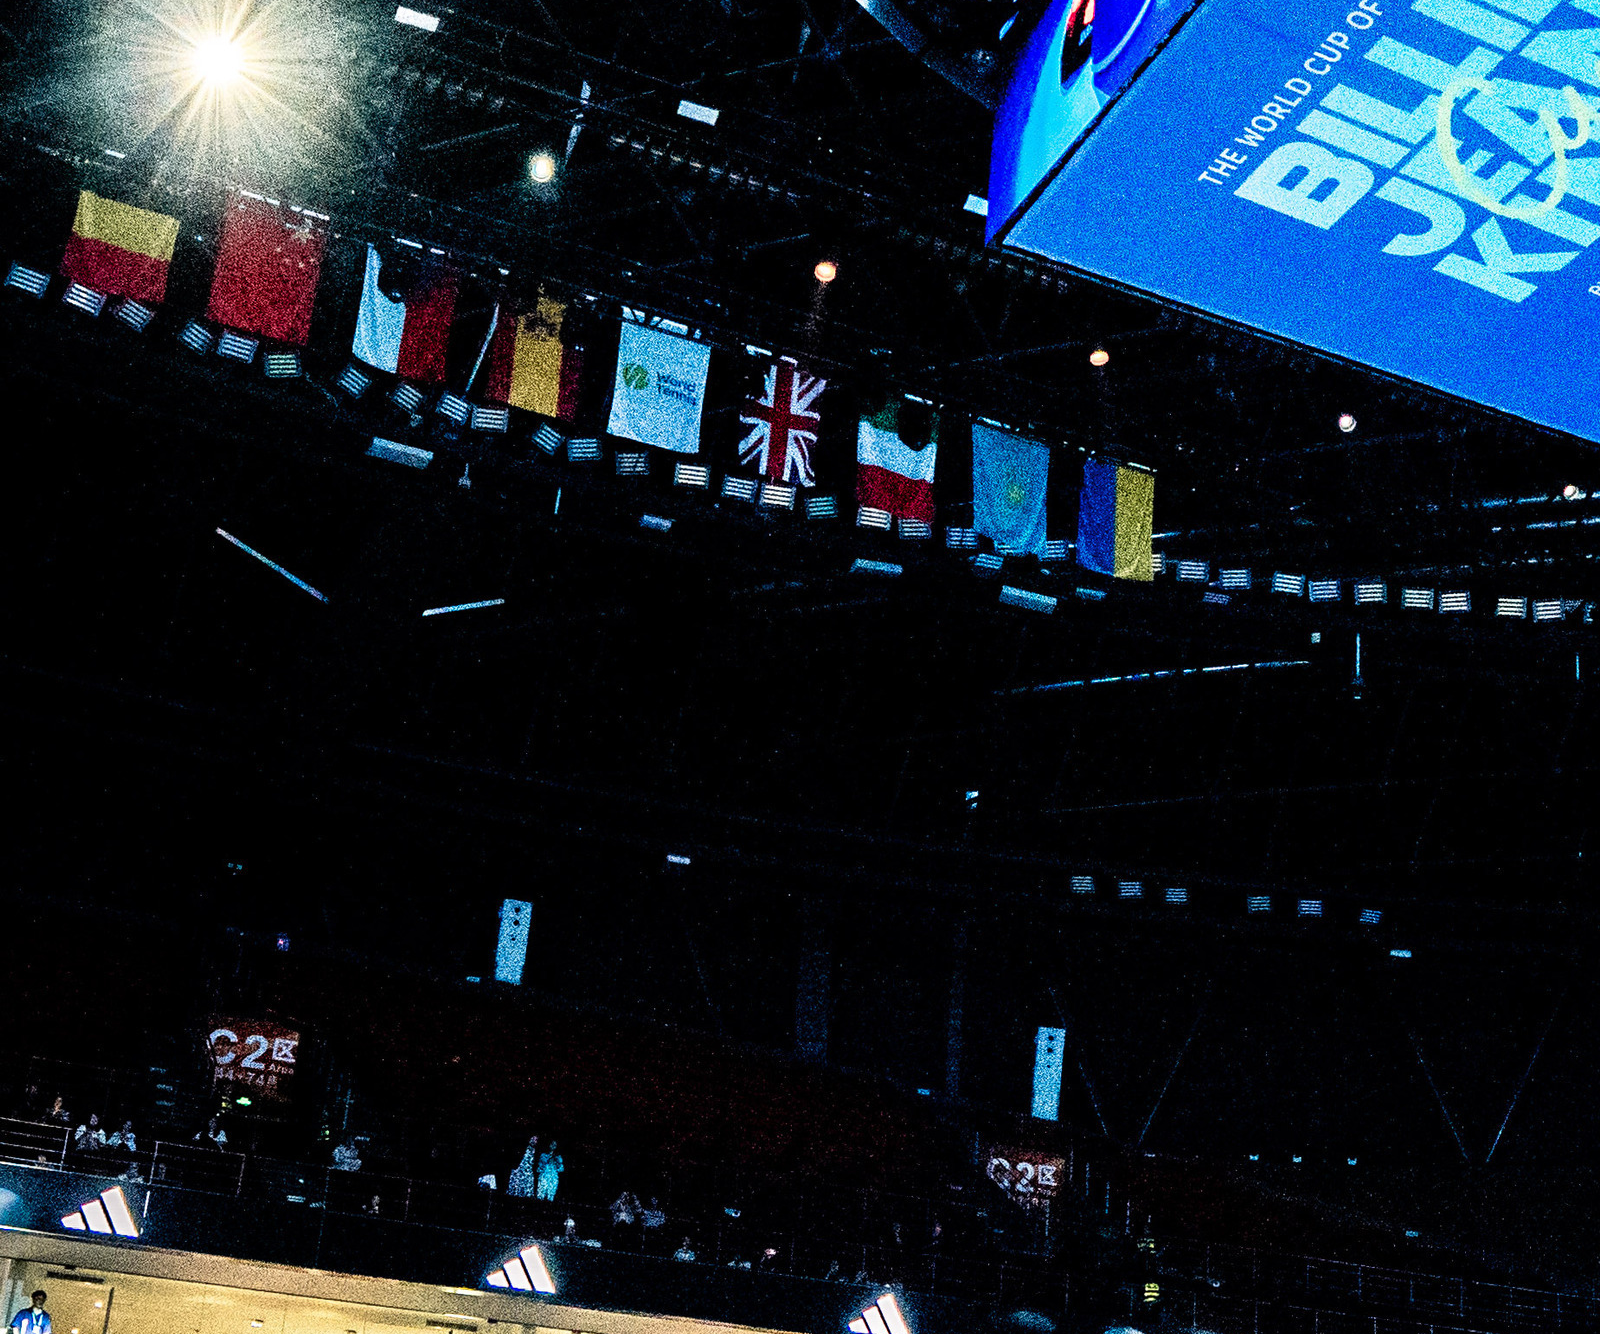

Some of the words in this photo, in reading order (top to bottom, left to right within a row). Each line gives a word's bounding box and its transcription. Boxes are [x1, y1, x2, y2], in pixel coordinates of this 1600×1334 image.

[1198, 147, 1247, 189] THE
[1237, 77, 1313, 149] WORLD
[1304, 31, 1350, 78] CUP
